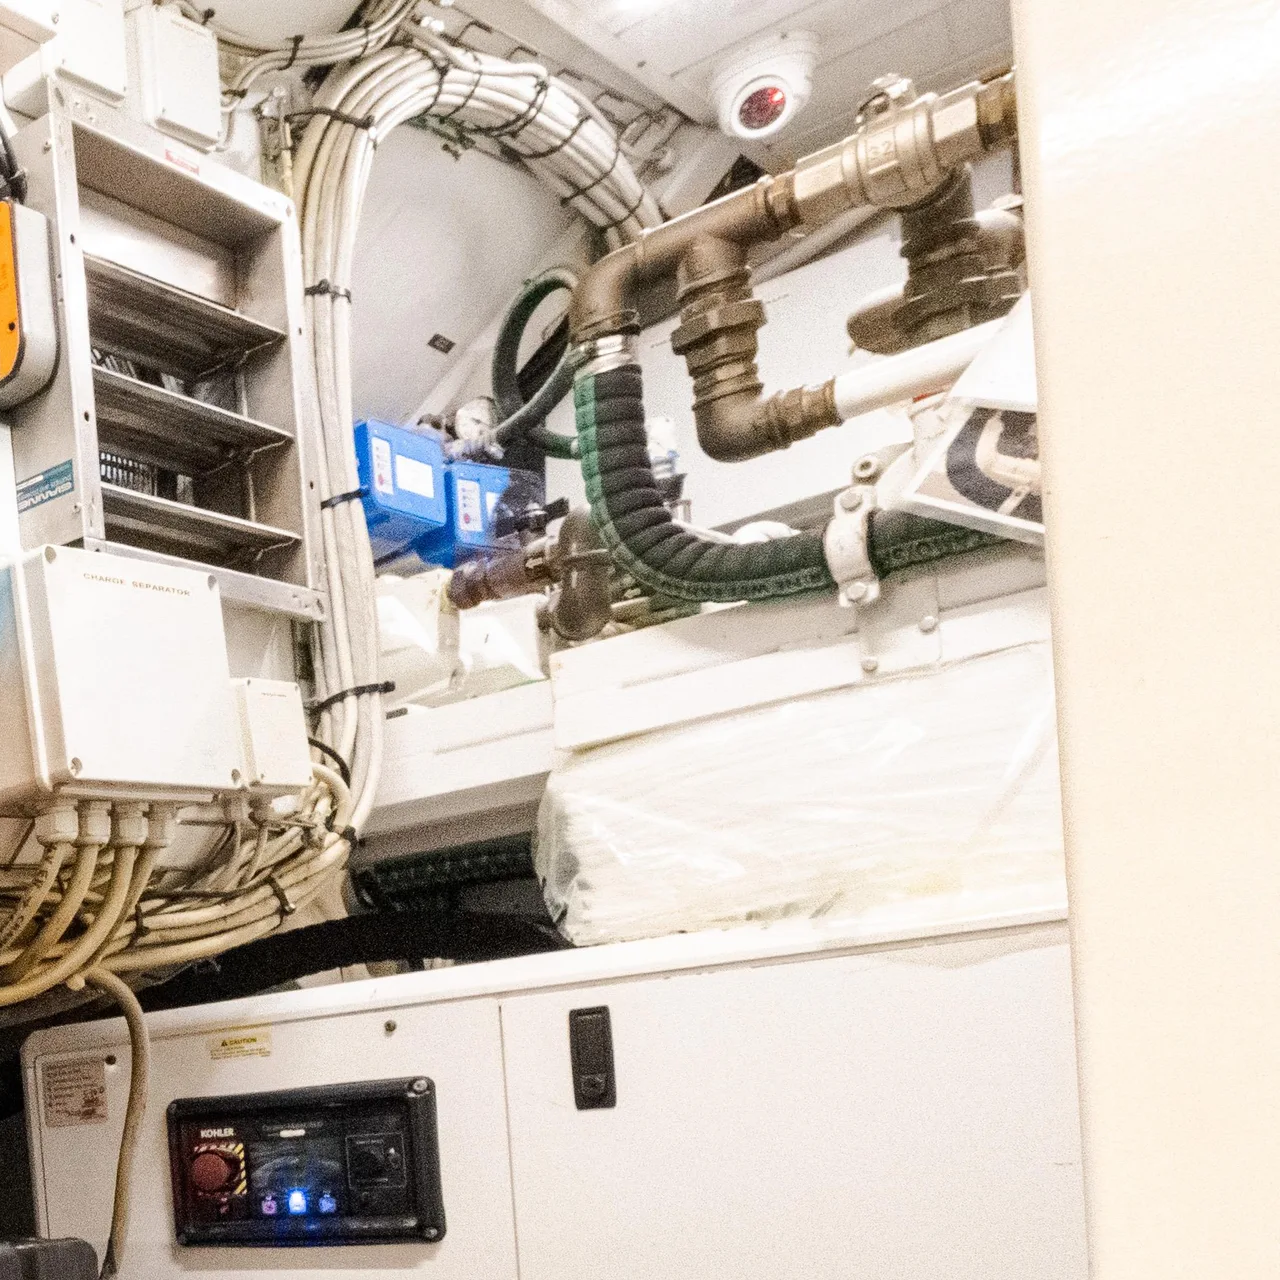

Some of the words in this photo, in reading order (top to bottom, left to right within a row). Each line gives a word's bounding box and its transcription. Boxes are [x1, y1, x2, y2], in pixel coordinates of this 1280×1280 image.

[83, 572, 126, 585] CHARGE
[132, 580, 191, 597] SEPARATOR
[229, 1037, 257, 1045] CAUTION
[200, 1127, 234, 1138] KOHLER
